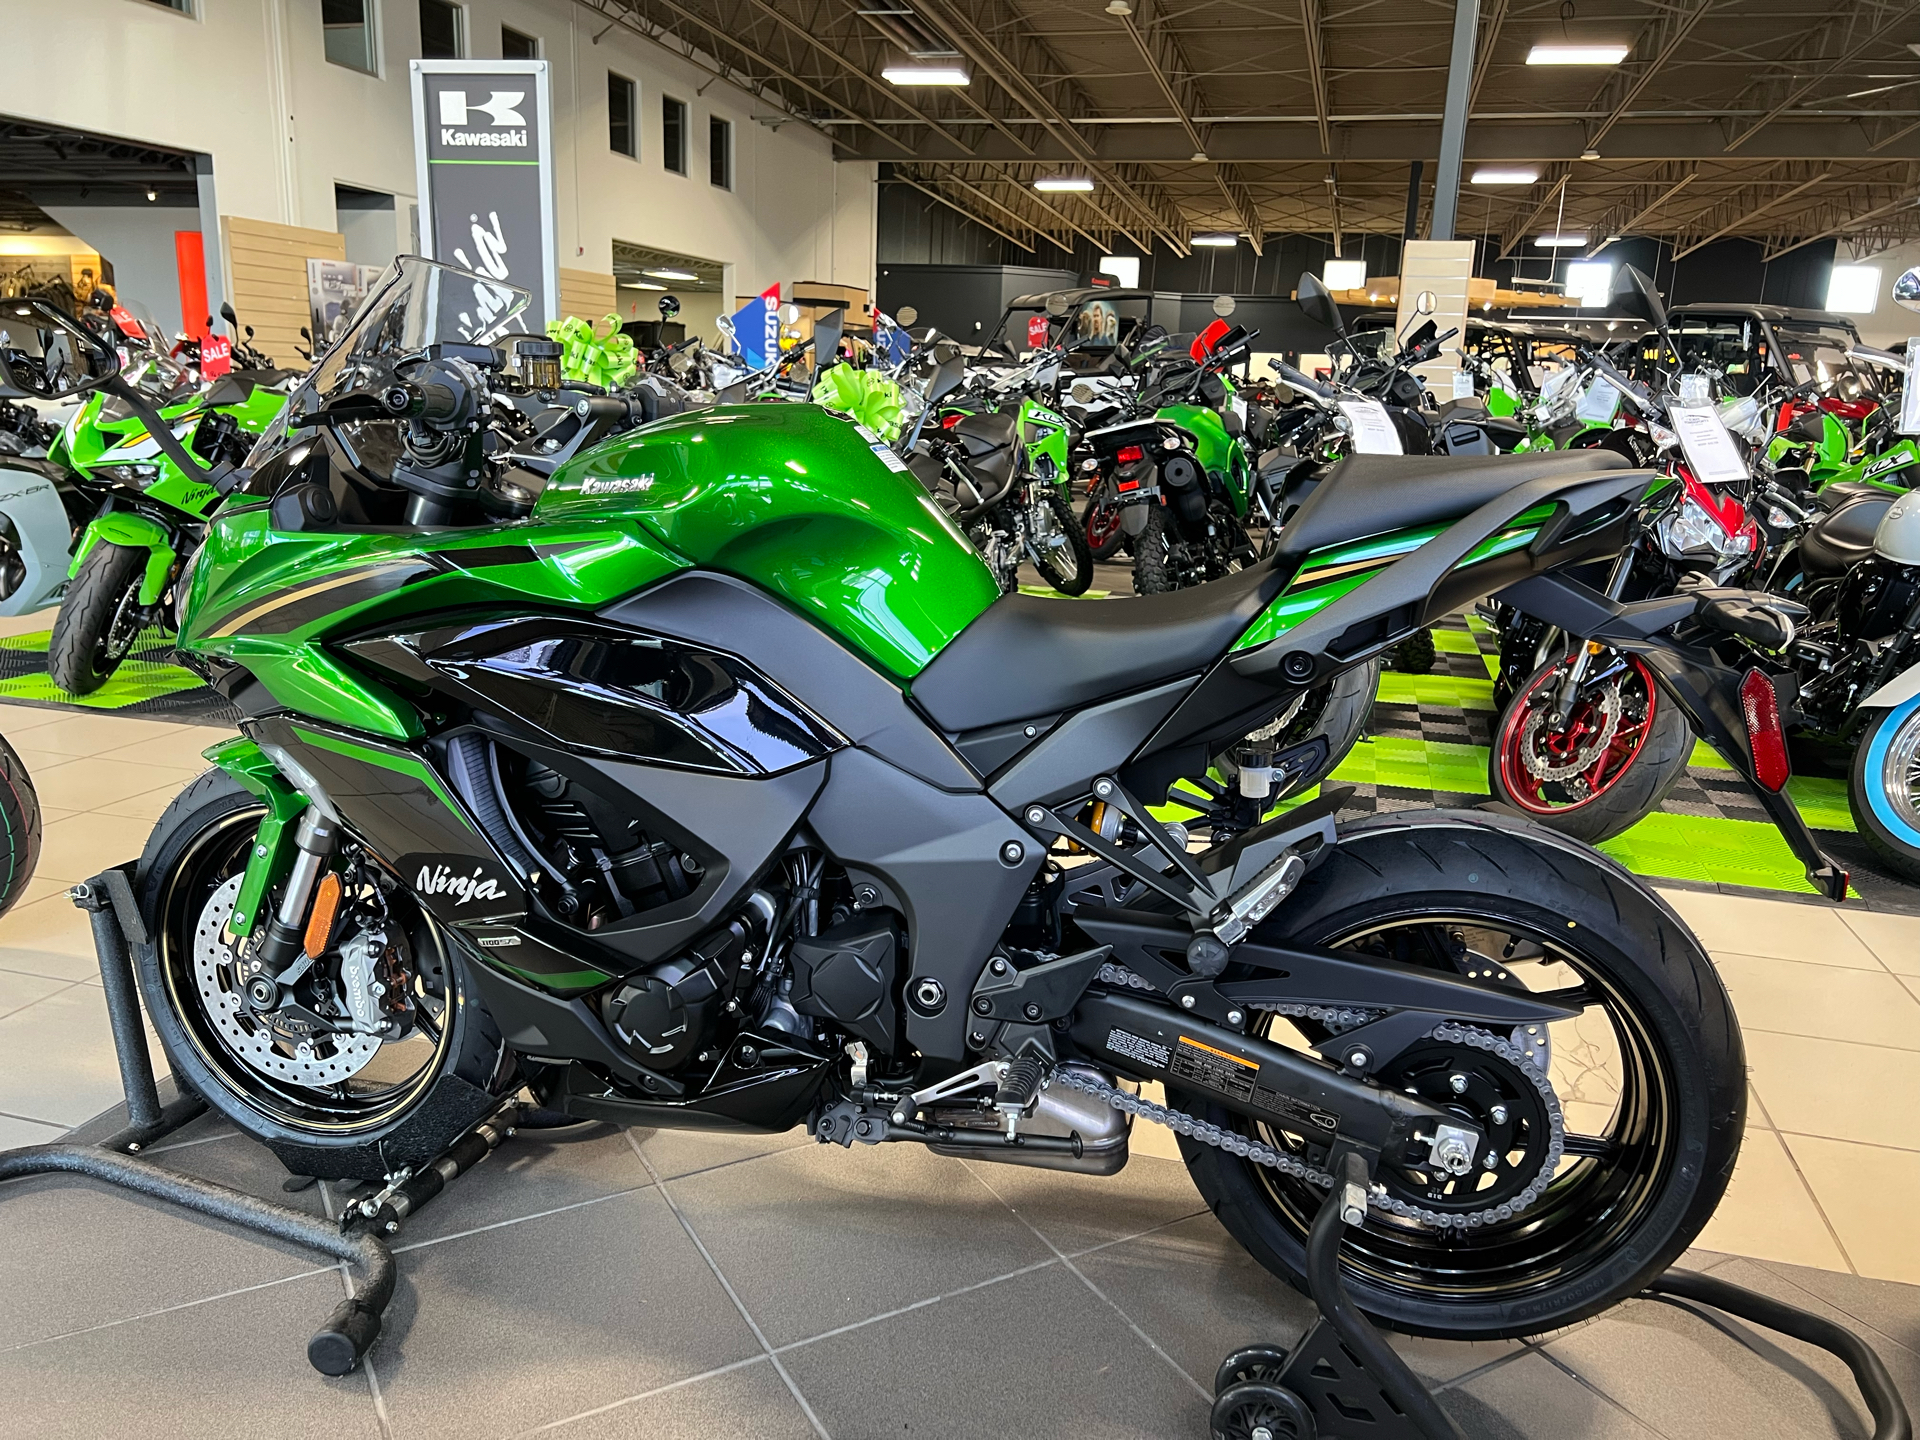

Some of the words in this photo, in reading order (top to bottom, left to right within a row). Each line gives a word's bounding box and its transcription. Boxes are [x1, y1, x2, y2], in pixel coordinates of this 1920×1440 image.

[441, 129, 527, 147] Kawasaki
[202, 342, 229, 363] SALE
[1861, 451, 1906, 480] KLX
[579, 472, 655, 495] Kawasaki
[416, 864, 507, 906] Ninja
[350, 966, 366, 1018] brembo
